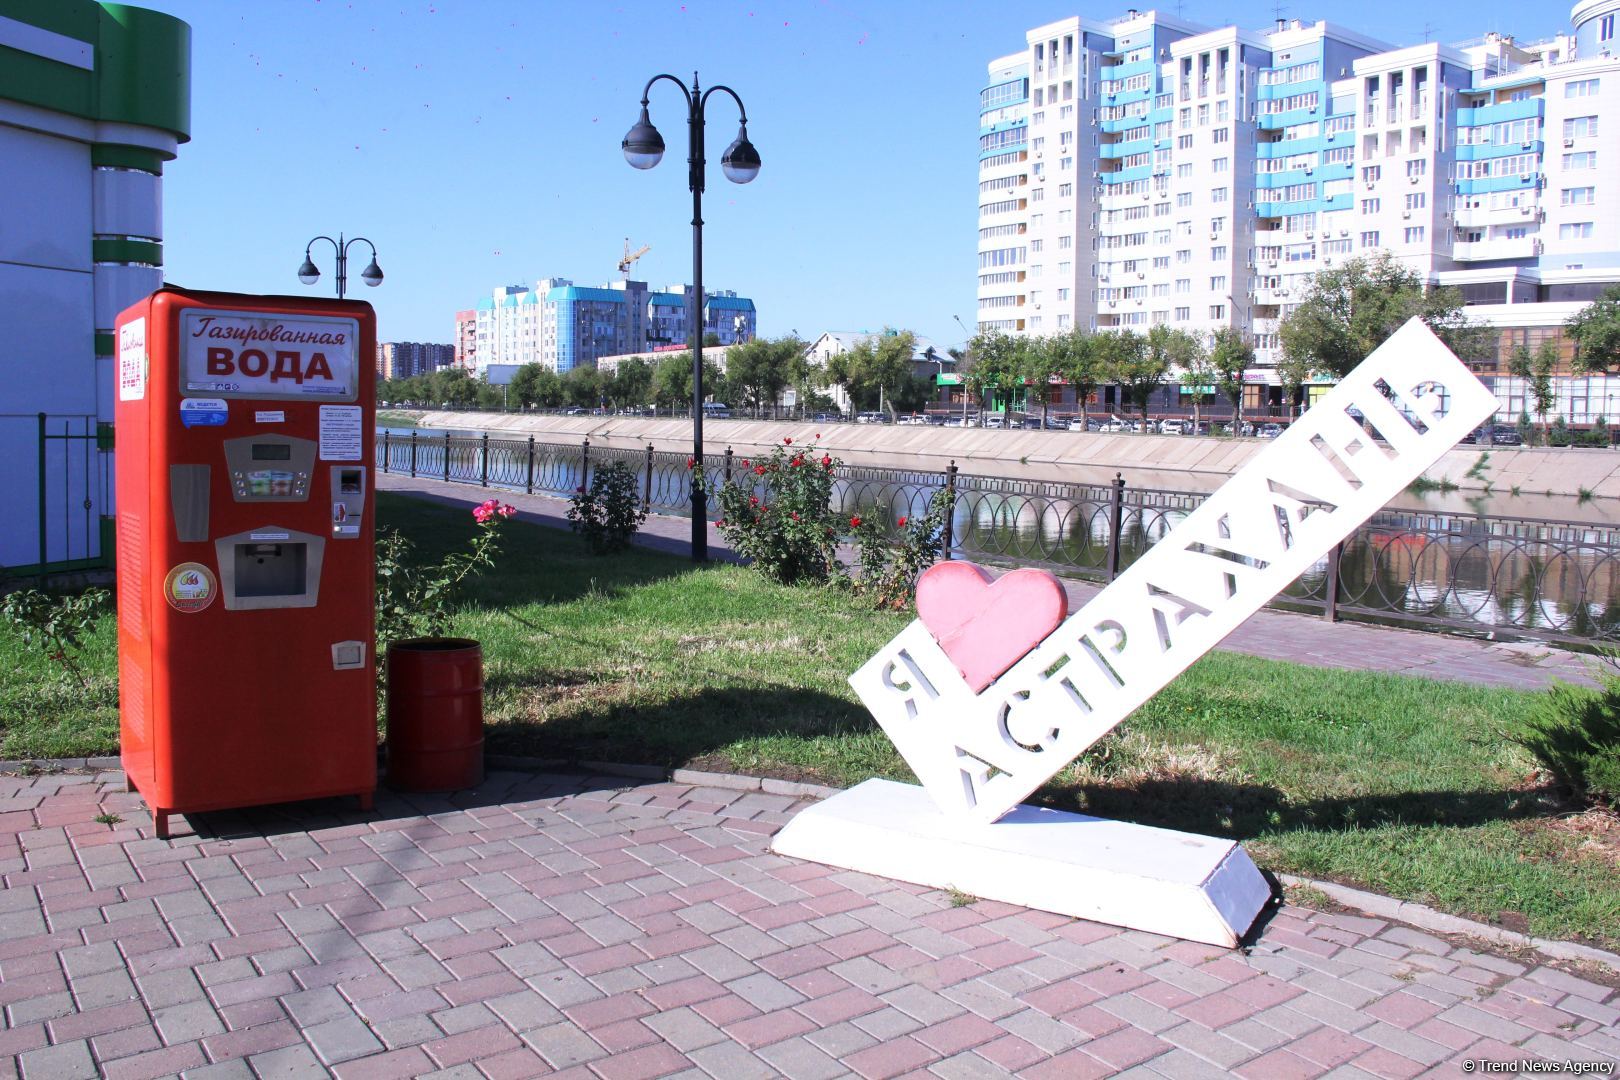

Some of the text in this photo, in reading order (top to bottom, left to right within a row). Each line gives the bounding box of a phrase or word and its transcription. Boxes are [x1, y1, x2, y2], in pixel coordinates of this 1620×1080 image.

[192, 317, 346, 346] Газированная
[207, 347, 333, 384] ВОДА
[954, 377, 1452, 810] АСТРАХАНЬ
[881, 648, 939, 721] Я
